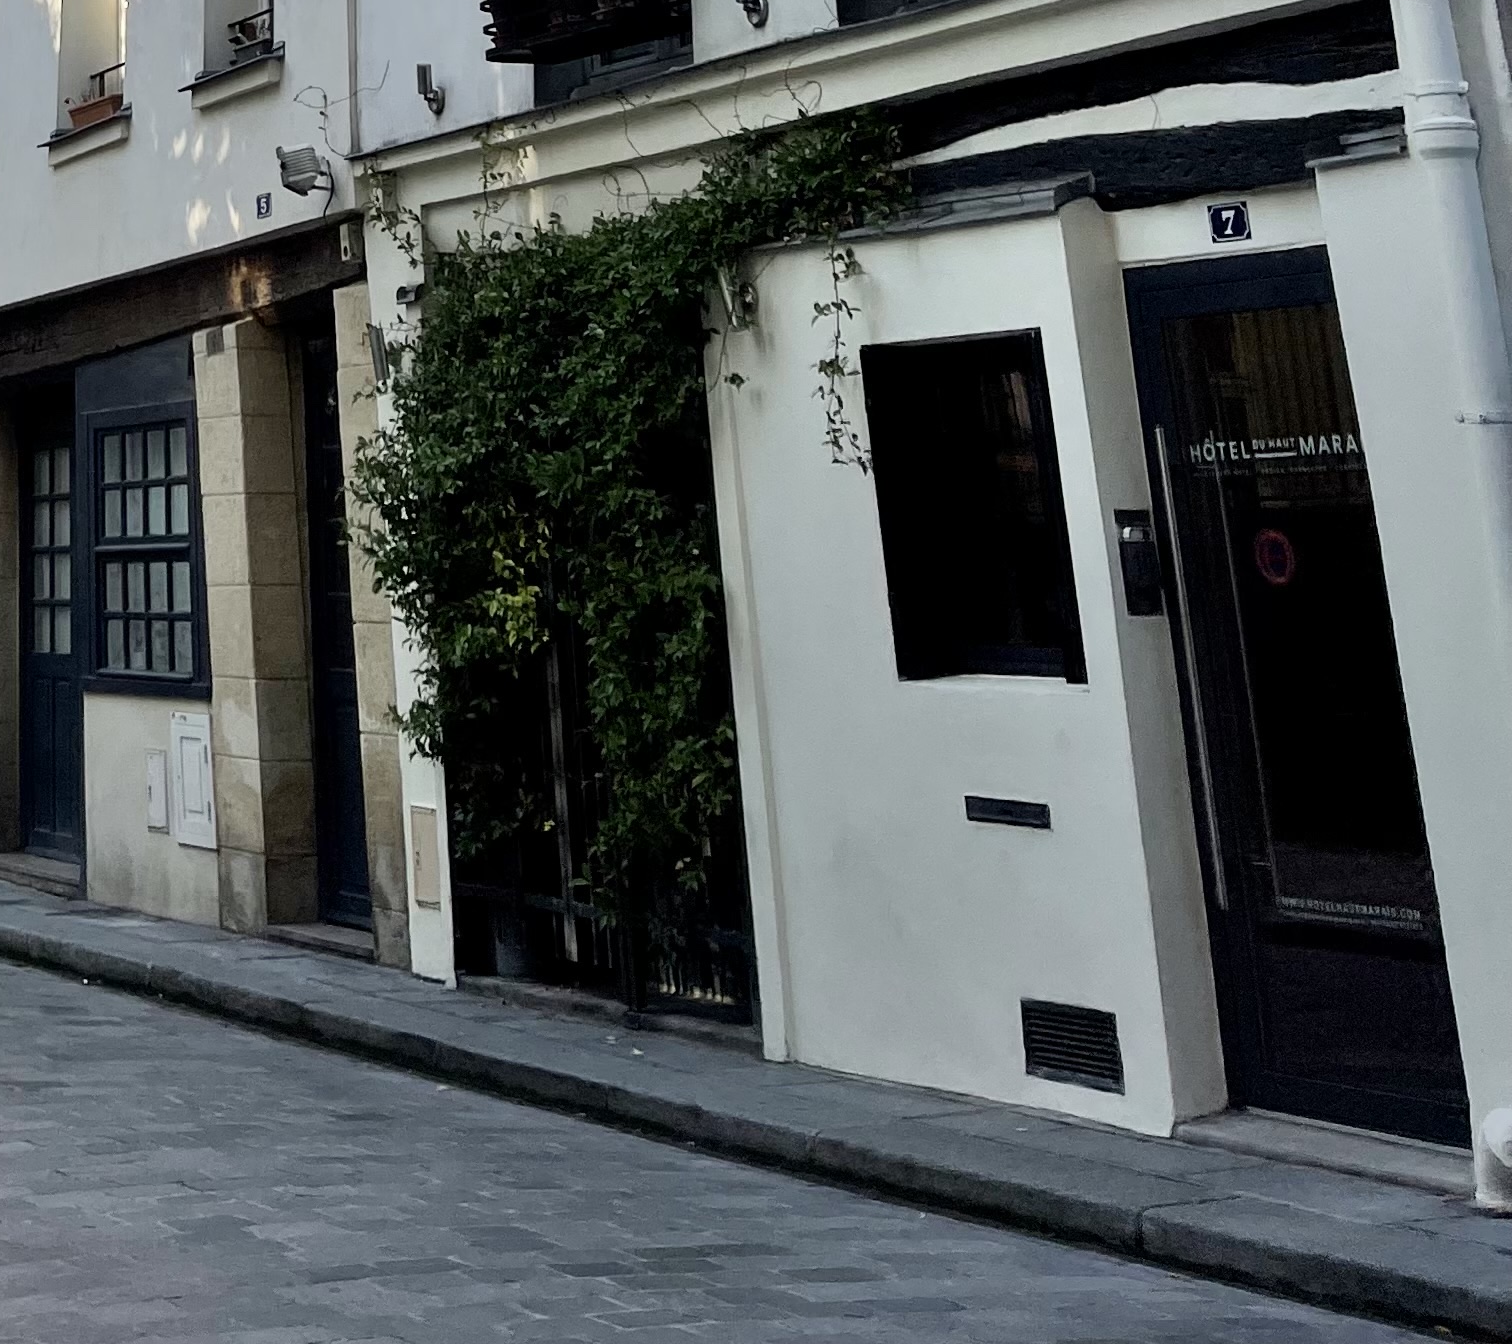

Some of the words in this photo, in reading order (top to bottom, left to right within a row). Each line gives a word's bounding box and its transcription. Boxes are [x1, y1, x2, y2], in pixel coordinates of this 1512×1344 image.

[260, 198, 267, 214] 5
[1221, 209, 1236, 235] 7
[1189, 437, 1251, 463] HÔTEL
